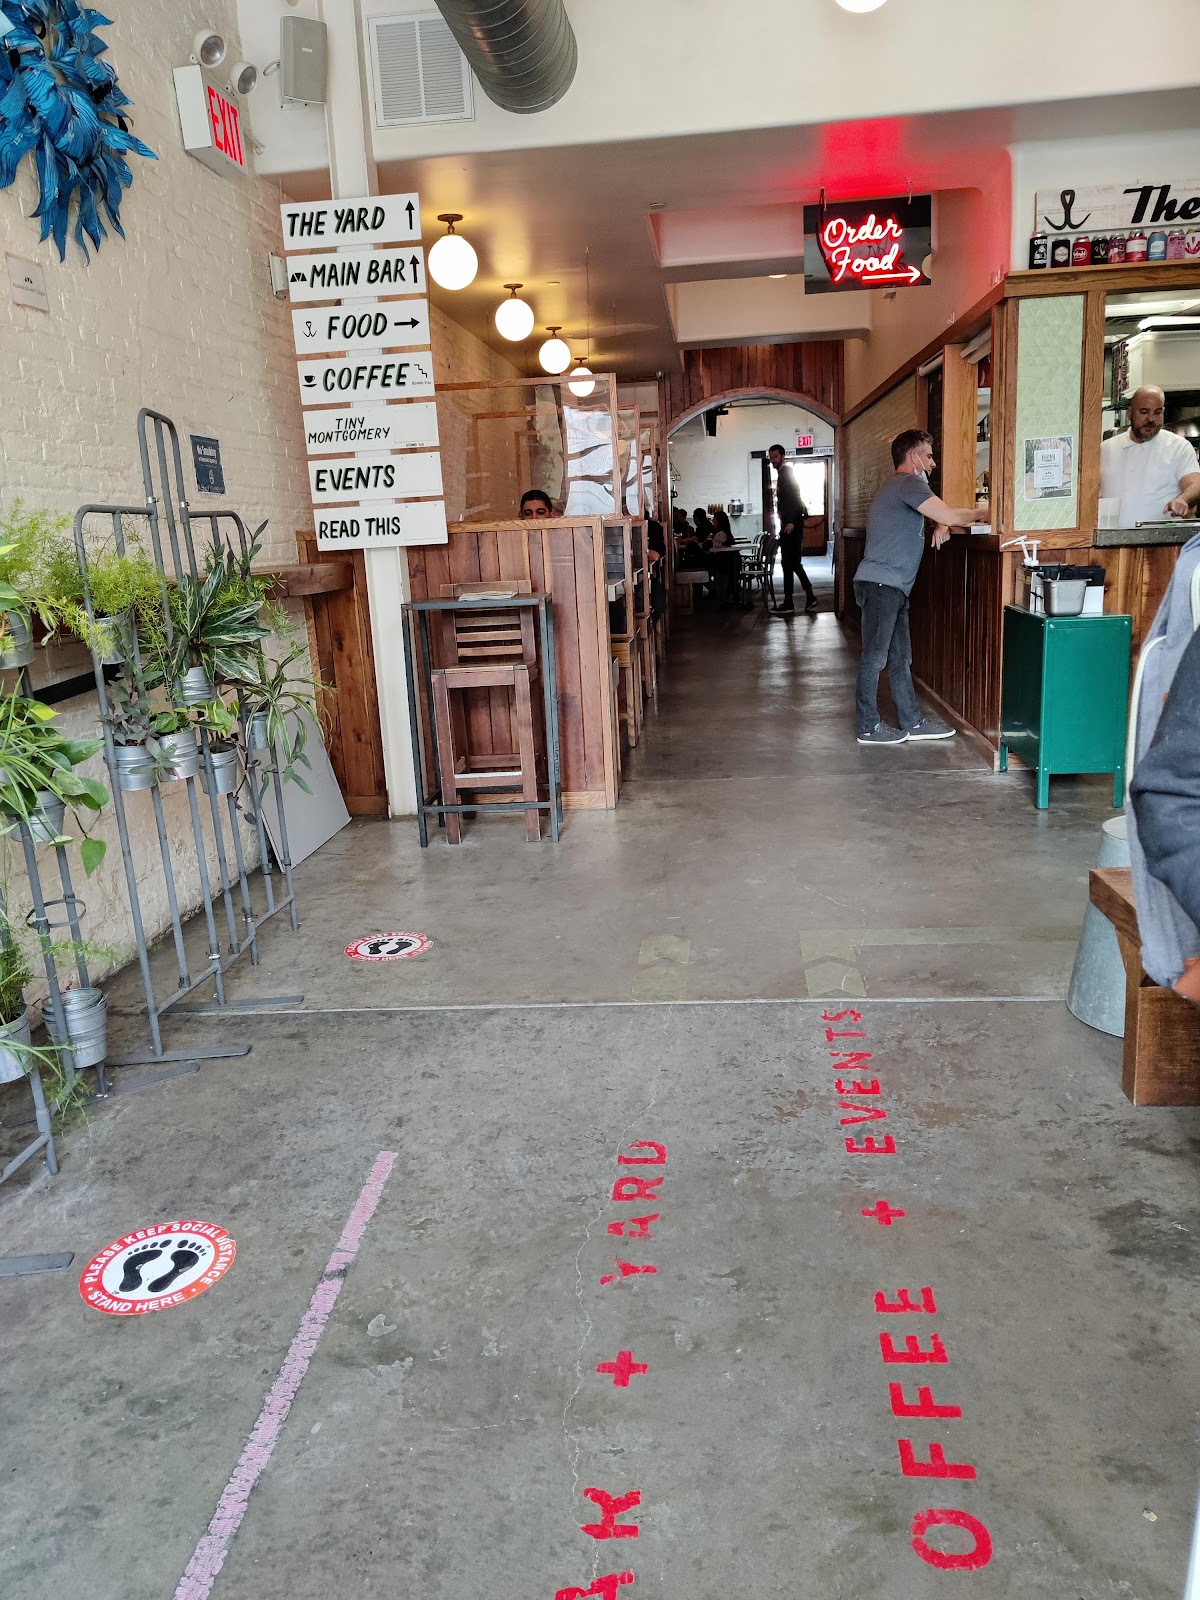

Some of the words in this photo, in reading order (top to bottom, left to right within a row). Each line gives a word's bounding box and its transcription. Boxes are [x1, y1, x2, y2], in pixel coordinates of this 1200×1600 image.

[207, 85, 243, 166] EXIT
[1123, 184, 1200, 224] The
[286, 210, 328, 238] THE
[334, 206, 386, 234] YARD
[824, 213, 903, 248] Order
[309, 261, 361, 289] MAIN
[366, 258, 406, 285] BAR
[831, 243, 900, 282] Food
[327, 312, 388, 340] FOOD
[322, 363, 410, 392] COFFEE
[308, 427, 391, 444] MONTGOMERY
[335, 416, 365, 430] TINY
[798, 436, 812, 446] EXIT
[315, 464, 395, 492] EVENTS
[319, 519, 361, 540] READ
[365, 516, 401, 537] THIS
[820, 1009, 897, 1155] EVENTS
[84, 1243, 124, 1285] PLEASE
[123, 1225, 168, 1245] KEEP
[171, 1222, 221, 1238] SOCIAL
[199, 1236, 233, 1285] DISTANCE
[87, 1290, 133, 1312] STAND
[135, 1292, 186, 1312] HERE
[874, 1286, 993, 1571] OFFEE
